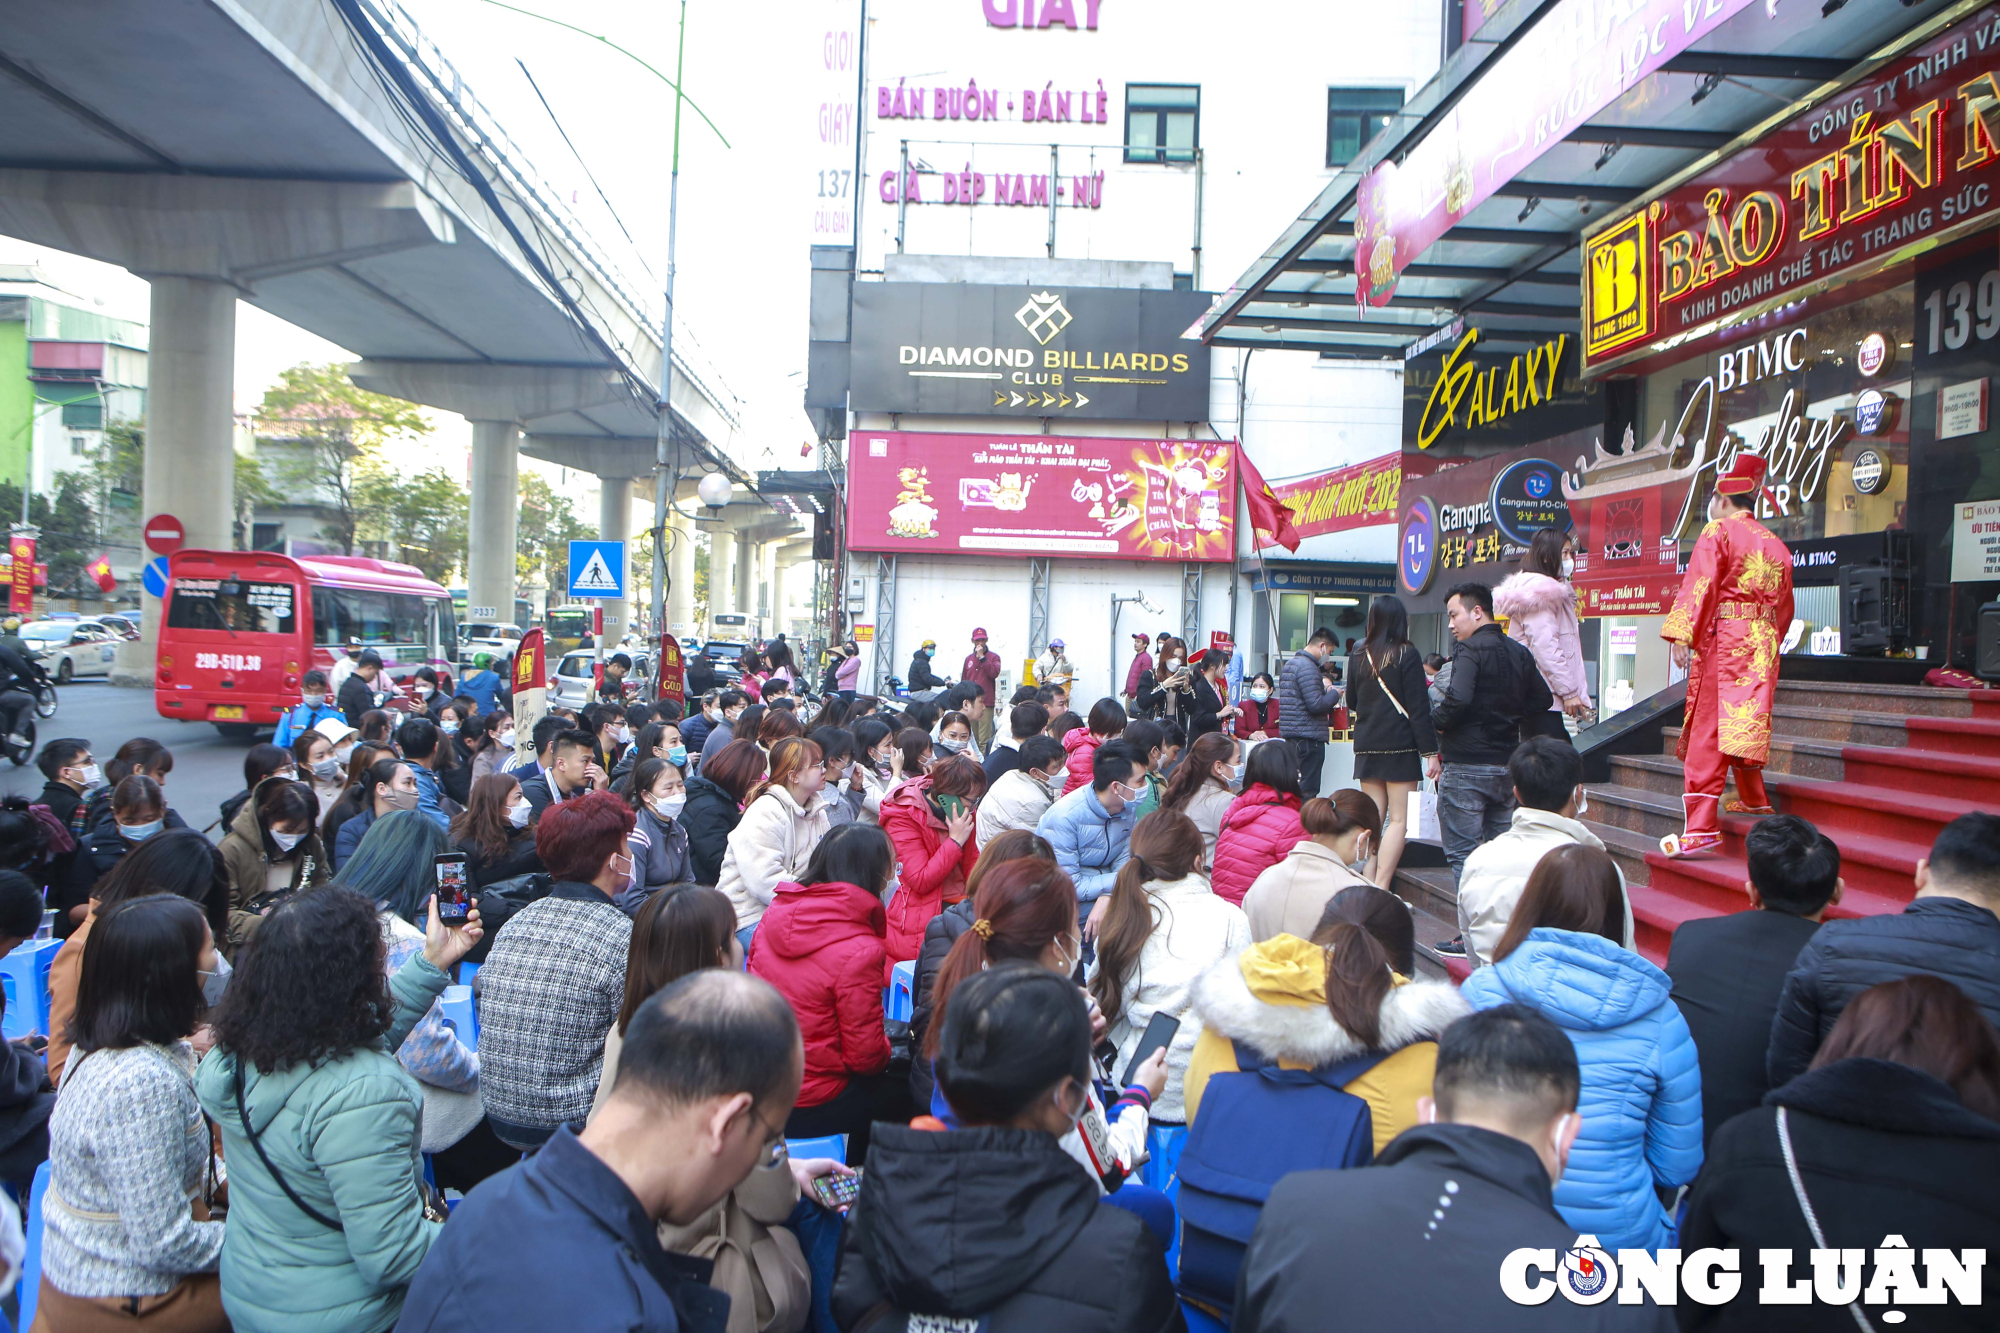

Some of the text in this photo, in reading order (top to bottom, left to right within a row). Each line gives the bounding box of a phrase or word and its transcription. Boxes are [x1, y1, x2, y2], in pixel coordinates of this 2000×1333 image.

[1611, 14, 1670, 88] LỘC
[878, 76, 924, 119] BÁN
[934, 77, 997, 120] BUÔN
[1023, 80, 1071, 123] BÁN
[1809, 97, 1864, 143] CÔNG
[1874, 76, 1899, 107] TY
[1904, 38, 1967, 90] TNHH
[818, 169, 851, 198] 137
[943, 161, 986, 205] DÉP
[995, 173, 1049, 206] NAM
[1659, 188, 1778, 303] BẢO
[1791, 111, 1938, 241] TÍN
[1681, 183, 1990, 325] KINH DOANH CHẾ TÁC TRANG SỨC
[1593, 310, 1637, 341] BTMC 1989
[1924, 269, 2000, 355] 139
[899, 346, 1190, 373] DIAMOND BILLIARDS
[1718, 327, 1807, 393] BTMC
[1863, 357, 1879, 368] GOLD
[1012, 371, 1063, 385] CLUB
[1417, 327, 1565, 449] GALAXY
[1055, 443, 1075, 455] TÀI
[1305, 478, 1342, 524] NĂM
[1336, 467, 1372, 518] MỚI
[1500, 497, 1538, 508] Gangnam
[1149, 506, 1167, 515] MINH
[1516, 510, 1533, 521] 강남
[1977, 505, 1995, 516] BẢO
[1441, 529, 1500, 569] 강남 포차
[1808, 550, 1837, 567] BTMC
[1292, 574, 1312, 584] CÔNG
[1313, 576, 1321, 584] TY
[1323, 576, 1332, 585] CP
[1334, 577, 1361, 586] THƯƠNG
[1362, 578, 1376, 588] MẠI
[1634, 584, 1645, 598] TÀI
[474, 607, 496, 617] P337
[663, 680, 681, 691] GOLD
